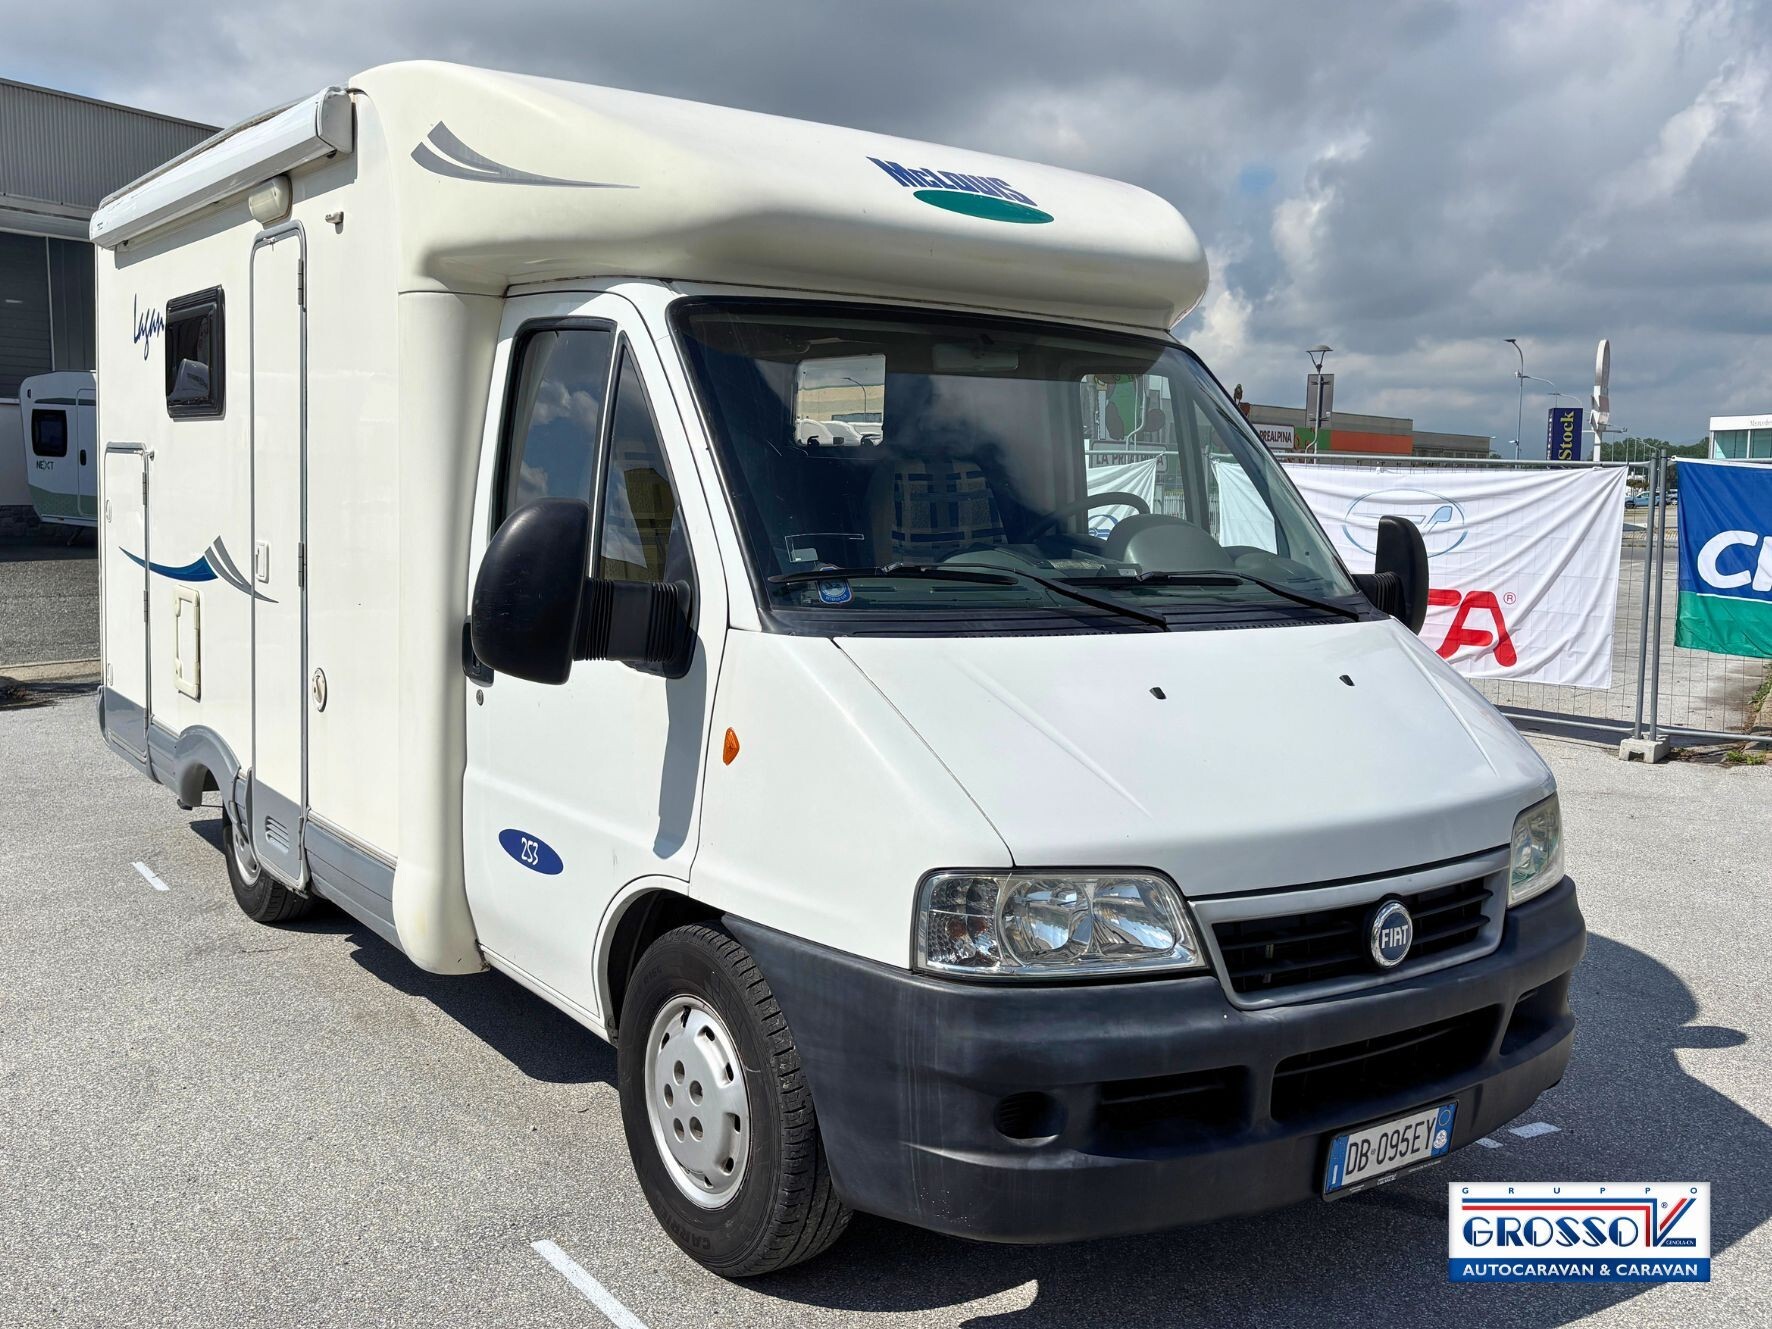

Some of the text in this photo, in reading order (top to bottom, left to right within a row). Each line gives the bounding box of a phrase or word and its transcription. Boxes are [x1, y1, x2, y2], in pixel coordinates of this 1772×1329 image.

[1558, 411, 1575, 460] Stock
[36, 460, 55, 470] NEXT
[521, 837, 539, 866] 253
[1381, 925, 1409, 949] FIAT
